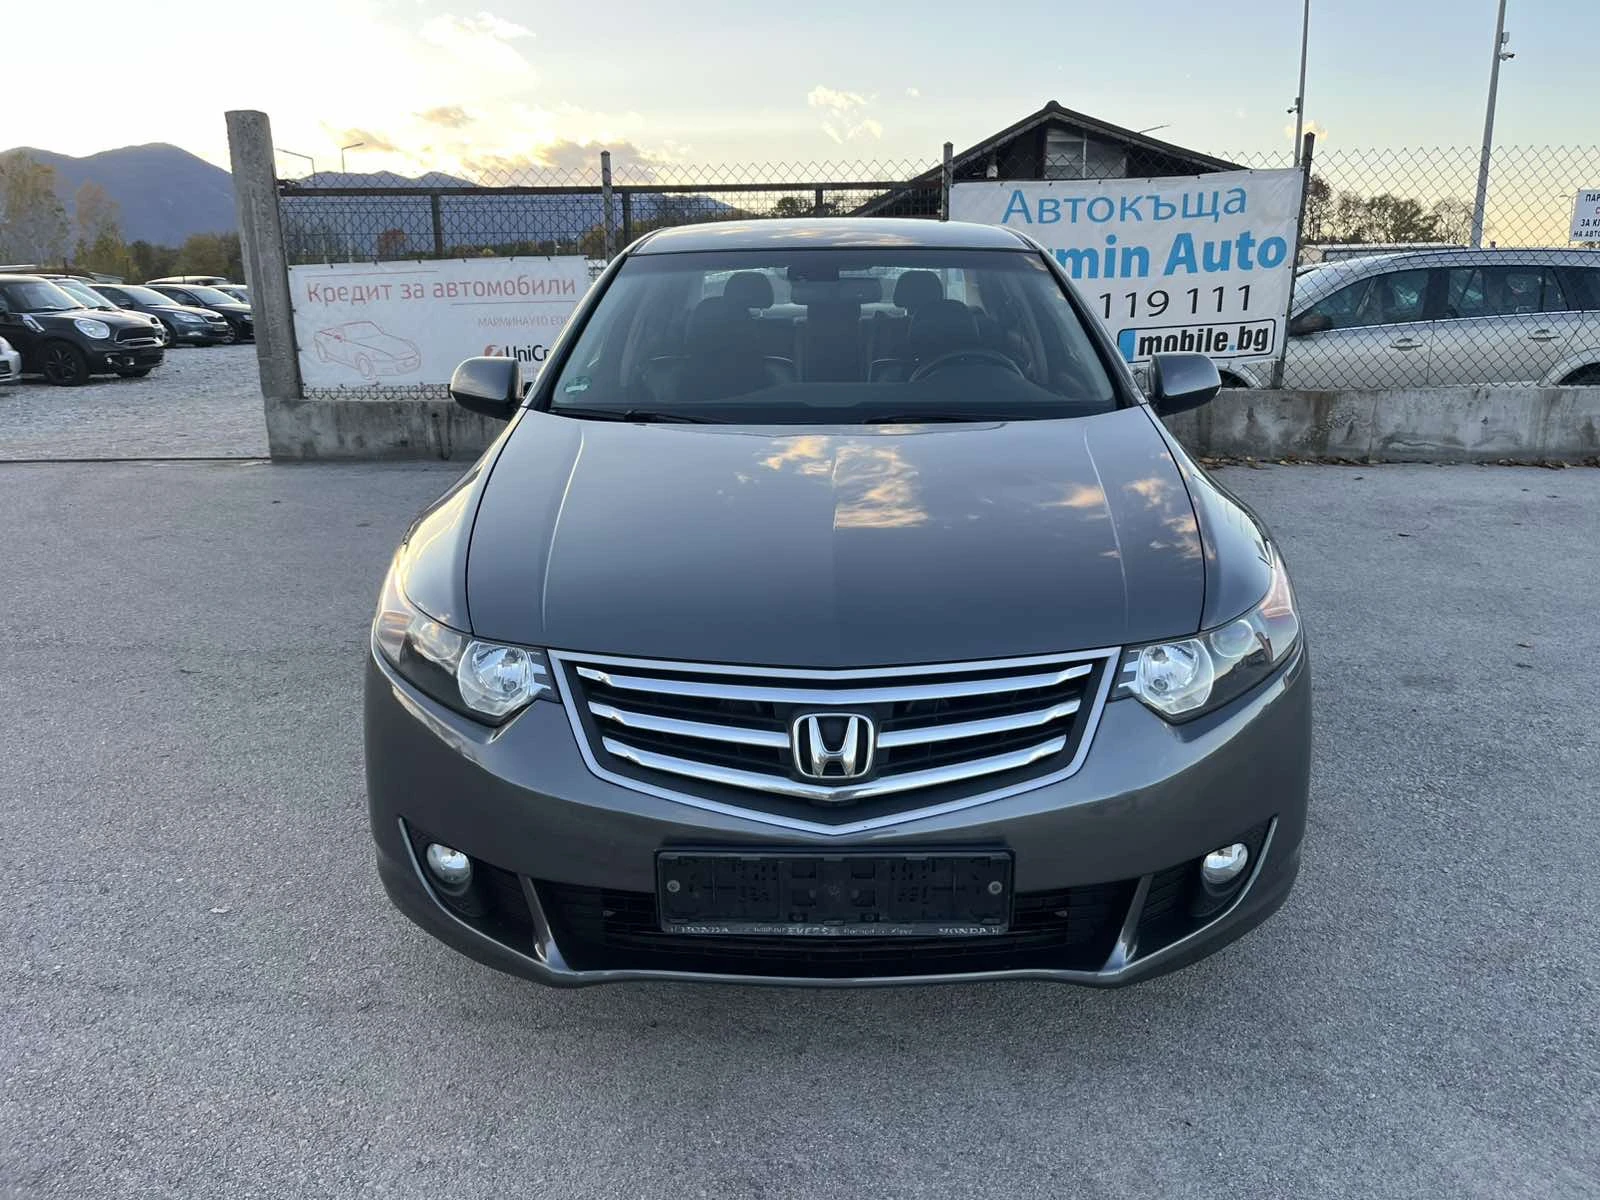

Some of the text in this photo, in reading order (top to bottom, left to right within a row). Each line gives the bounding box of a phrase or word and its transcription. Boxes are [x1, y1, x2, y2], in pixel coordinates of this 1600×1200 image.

[1001, 187, 1247, 225] Автокъща
[1048, 230, 1288, 280] min Auto
[307, 274, 577, 307] Кредит за автомобили
[1099, 284, 1251, 320] 119 111
[1138, 325, 1269, 356] mobile.bg
